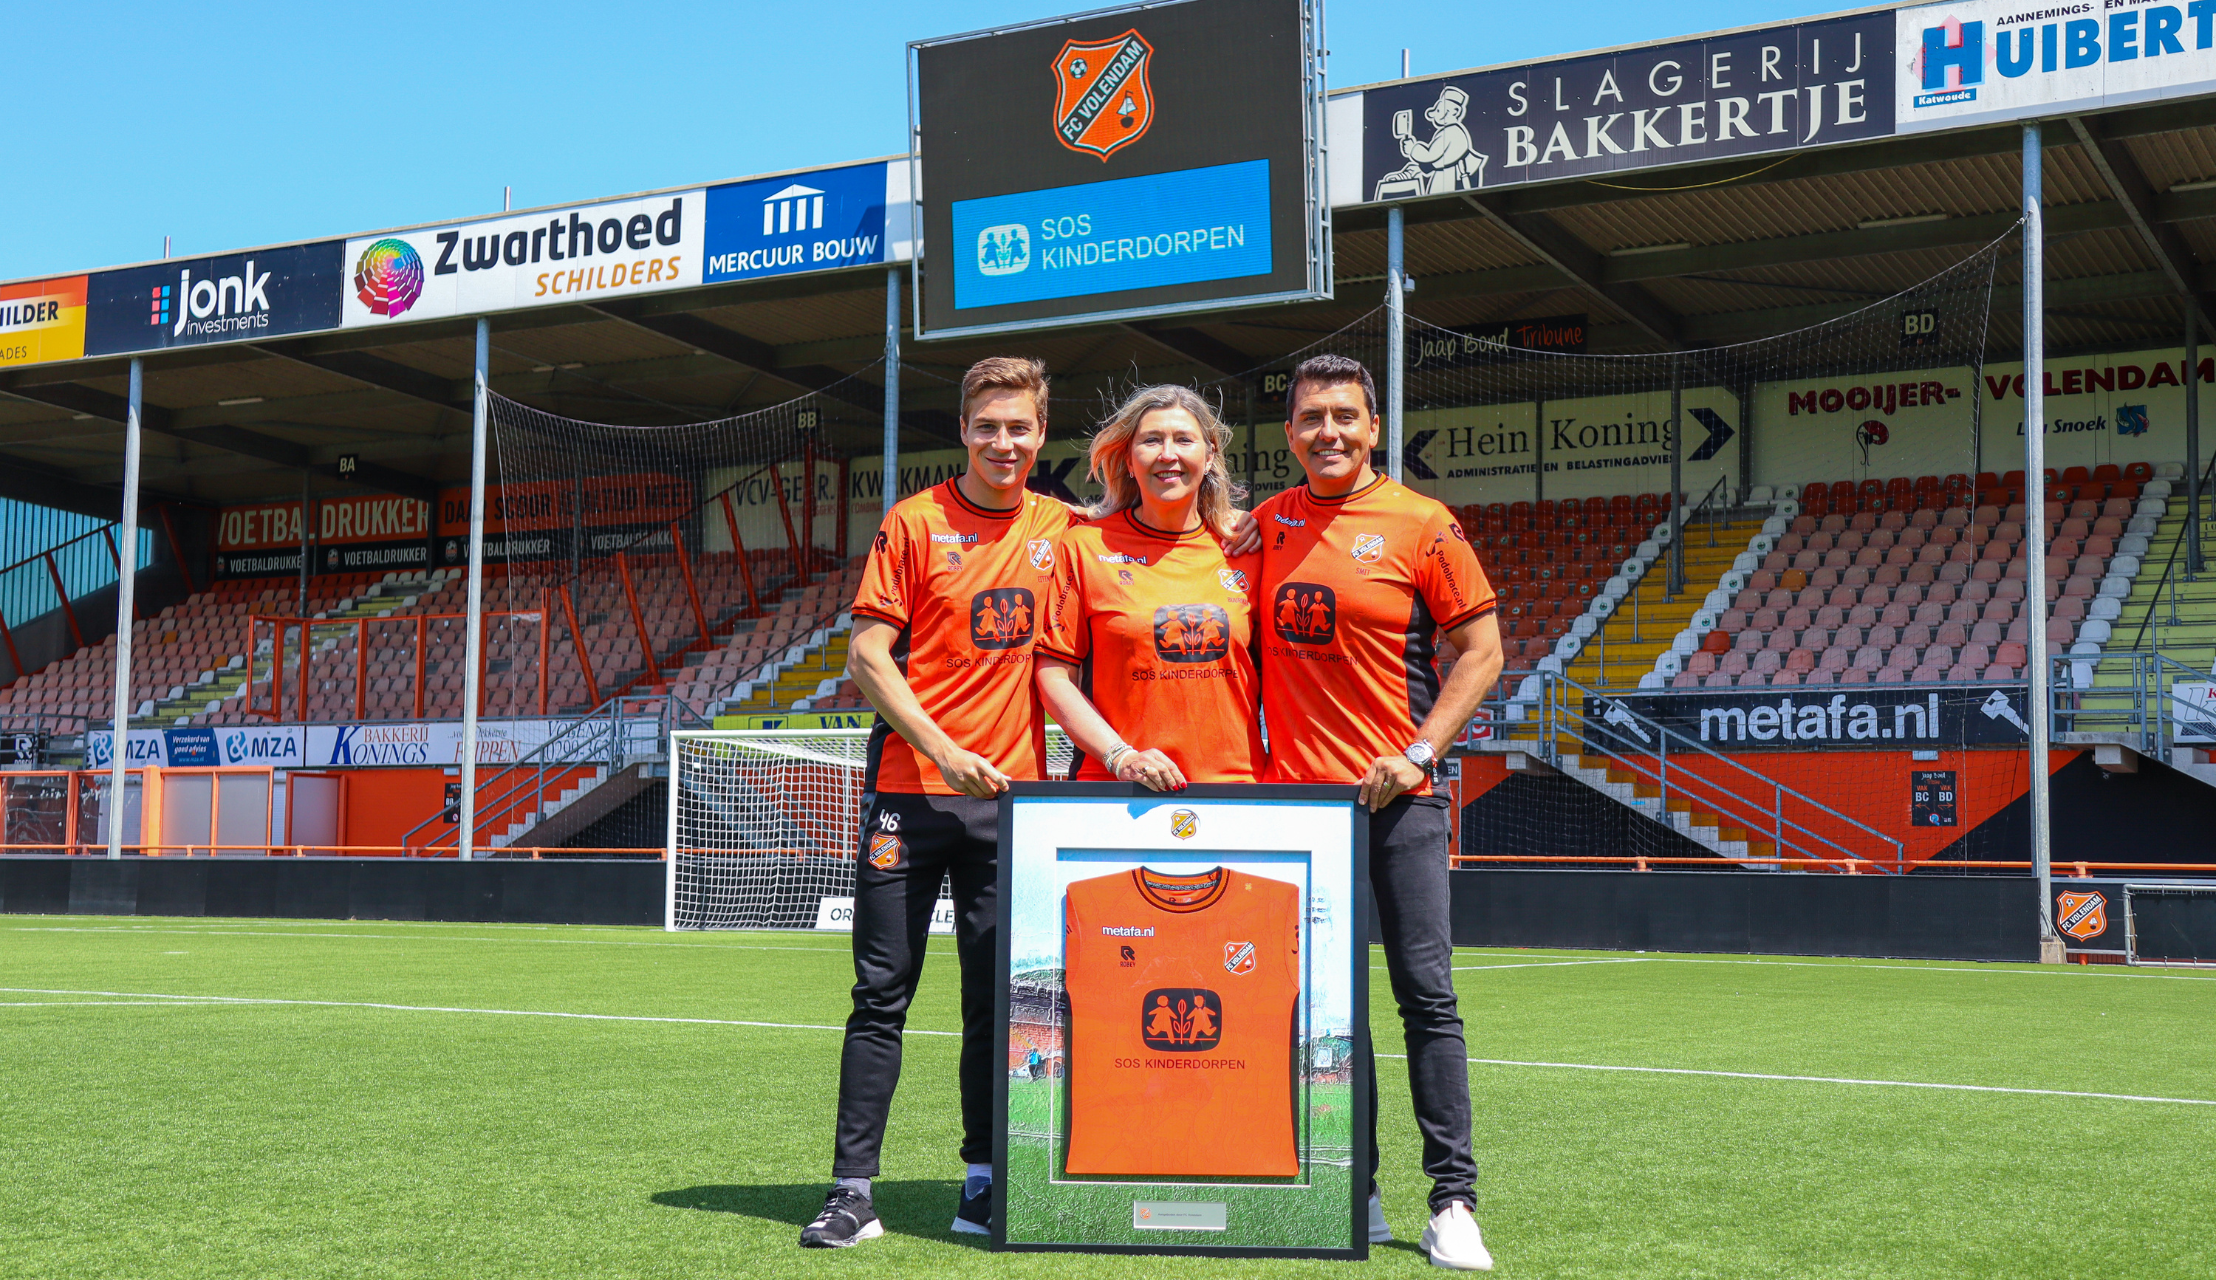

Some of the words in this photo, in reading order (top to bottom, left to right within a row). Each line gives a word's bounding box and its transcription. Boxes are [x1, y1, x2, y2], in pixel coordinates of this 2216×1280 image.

[1996, 6, 2094, 26] AANNEMINGS-
[1507, 32, 1862, 116] SLAGERIJ
[1062, 117, 1083, 140] FC
[1078, 40, 1144, 119] VOLENDAM
[1918, 91, 1971, 106] Katwoude
[1503, 78, 1866, 168] BAKKERTJE
[434, 198, 682, 276] Zwarthoed
[1040, 214, 1092, 241] SOS
[708, 246, 803, 275] MERCUUR
[812, 235, 878, 262] BOUW
[1042, 224, 1244, 271] KINDERDORPEN
[535, 256, 681, 297] SCHILDERS
[174, 260, 271, 337] jonk
[187, 311, 269, 336] investments
[1905, 314, 1934, 334] BD
[1413, 334, 1456, 367] Jaap
[1463, 327, 1508, 353] Bond
[1517, 323, 1584, 347] Tribune
[1264, 374, 1286, 393] BC
[1788, 381, 1961, 416] MOOIJER-
[798, 411, 817, 428] BB
[2052, 415, 2107, 434] Snoek
[1447, 420, 1530, 458] Hein
[1551, 412, 1682, 450] Koning
[339, 457, 355, 472] BA
[1447, 463, 1537, 478] ADMINISTRATIE
[1544, 462, 1558, 472] EN
[931, 532, 978, 543] metafa.nl
[344, 547, 427, 566] VOETBALDRUKKER
[1436, 550, 1467, 609] Podobrace.nl
[946, 658, 970, 669] SOS
[1132, 671, 1156, 682] SOS
[819, 715, 861, 729] VAN
[1700, 692, 1941, 742] metafa.nl
[328, 725, 429, 764] KONINGS
[454, 740, 521, 762] FIPPEN
[364, 727, 429, 742] BAKKERIJ
[251, 737, 296, 757] MZA
[1915, 792, 1929, 802] BC
[1939, 792, 1953, 802] BD
[880, 809, 900, 831] 46
[2061, 921, 2072, 931] FC
[2069, 895, 2102, 924] VOLENDAM
[1102, 926, 1155, 937] metafa.nl
[1230, 942, 1254, 967] VOLENDAM
[1114, 1058, 1141, 1069] SOS
[1145, 1058, 1245, 1070] KINDERDORPEN
